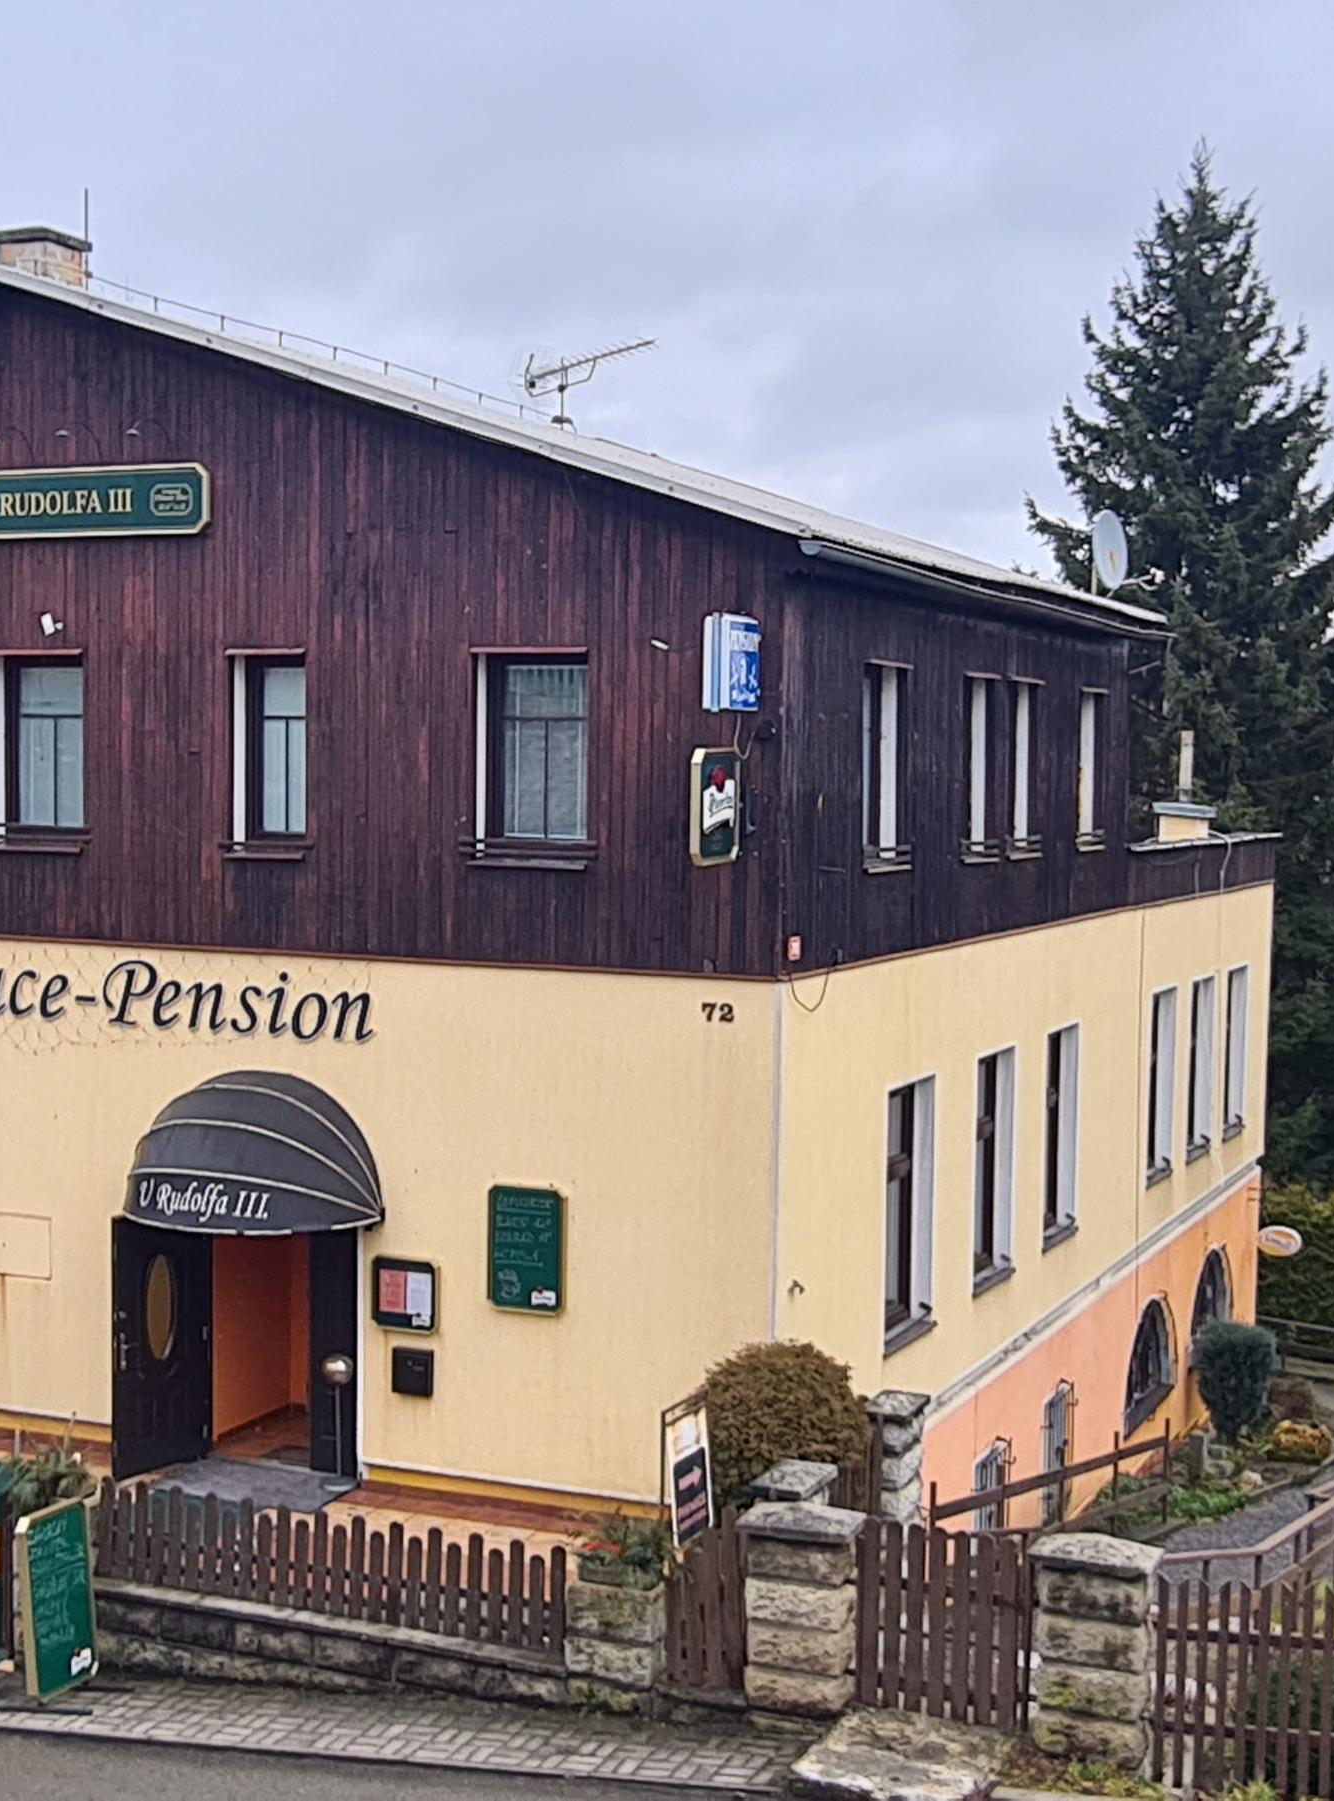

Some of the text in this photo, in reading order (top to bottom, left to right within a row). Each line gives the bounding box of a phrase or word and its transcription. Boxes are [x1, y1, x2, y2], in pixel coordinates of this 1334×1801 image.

[0, 489, 103, 517] RUDOLFA
[107, 487, 133, 513] III
[701, 1003, 735, 1023] 72
[138, 1177, 271, 1223] U Rudolfa III.
